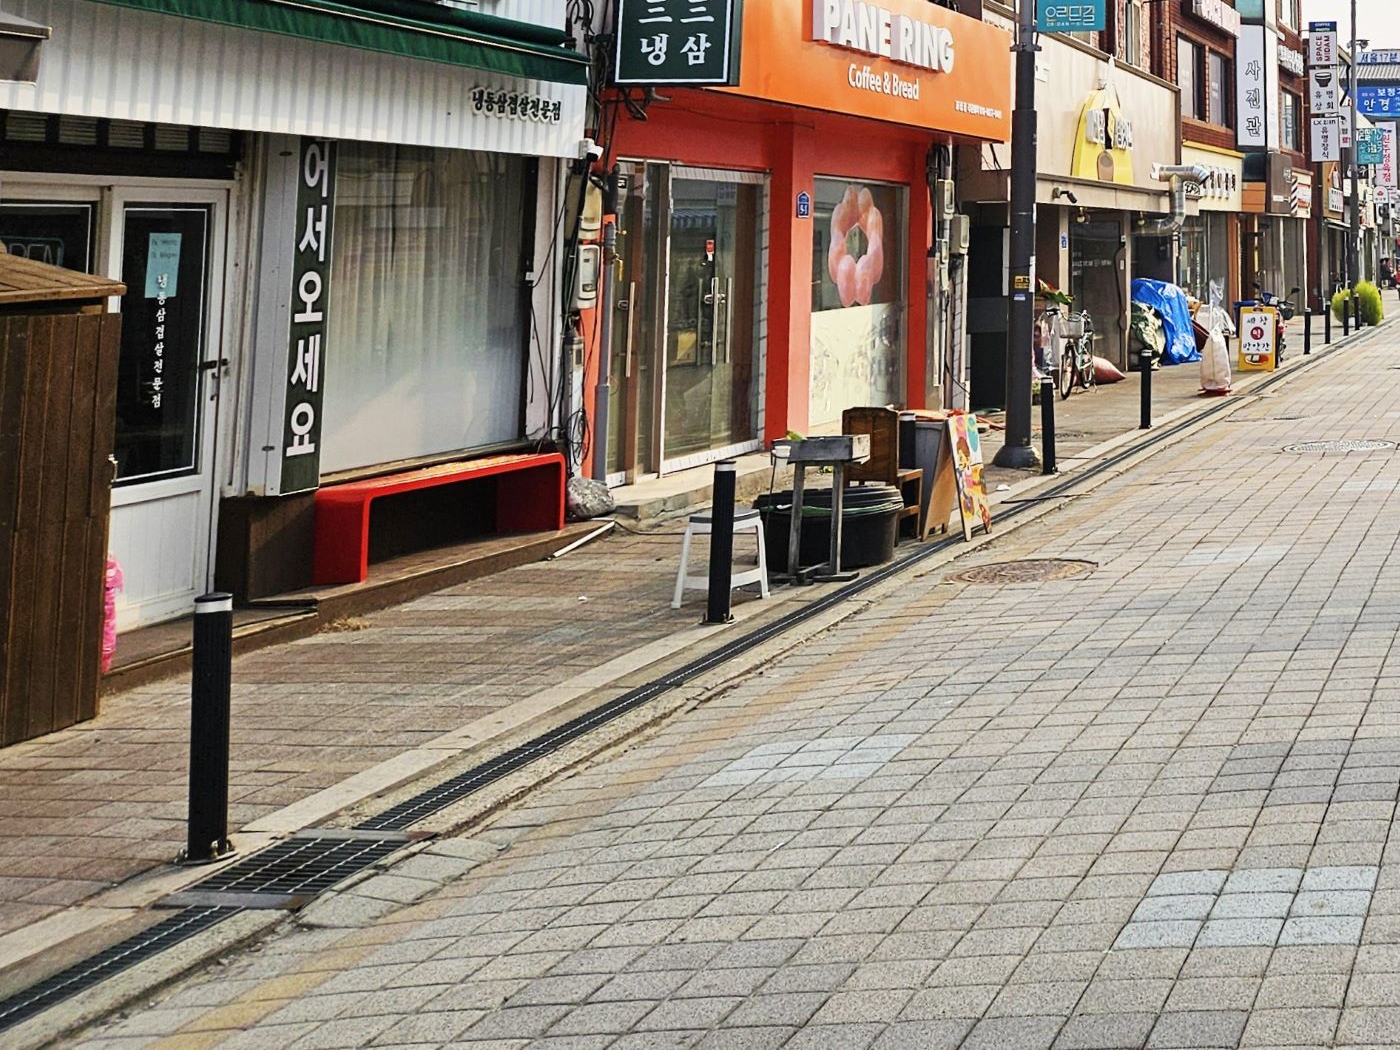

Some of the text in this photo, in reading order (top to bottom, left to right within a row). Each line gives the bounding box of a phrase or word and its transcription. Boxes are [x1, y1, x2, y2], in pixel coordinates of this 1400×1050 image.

[639, 33, 713, 66] 냉삼
[900, 14, 954, 75] RING
[1315, 35, 1323, 62] SPACE
[847, 62, 920, 102] Coffee & Bread
[1244, 60, 1263, 138] 사진관
[1314, 89, 1333, 100] 유명
[471, 89, 562, 122] 냉동삼겹살전문점
[1363, 98, 1390, 111] 안경
[286, 143, 329, 458] 어서오세요
[151, 273, 169, 409] 냉동삼겹살전문점
